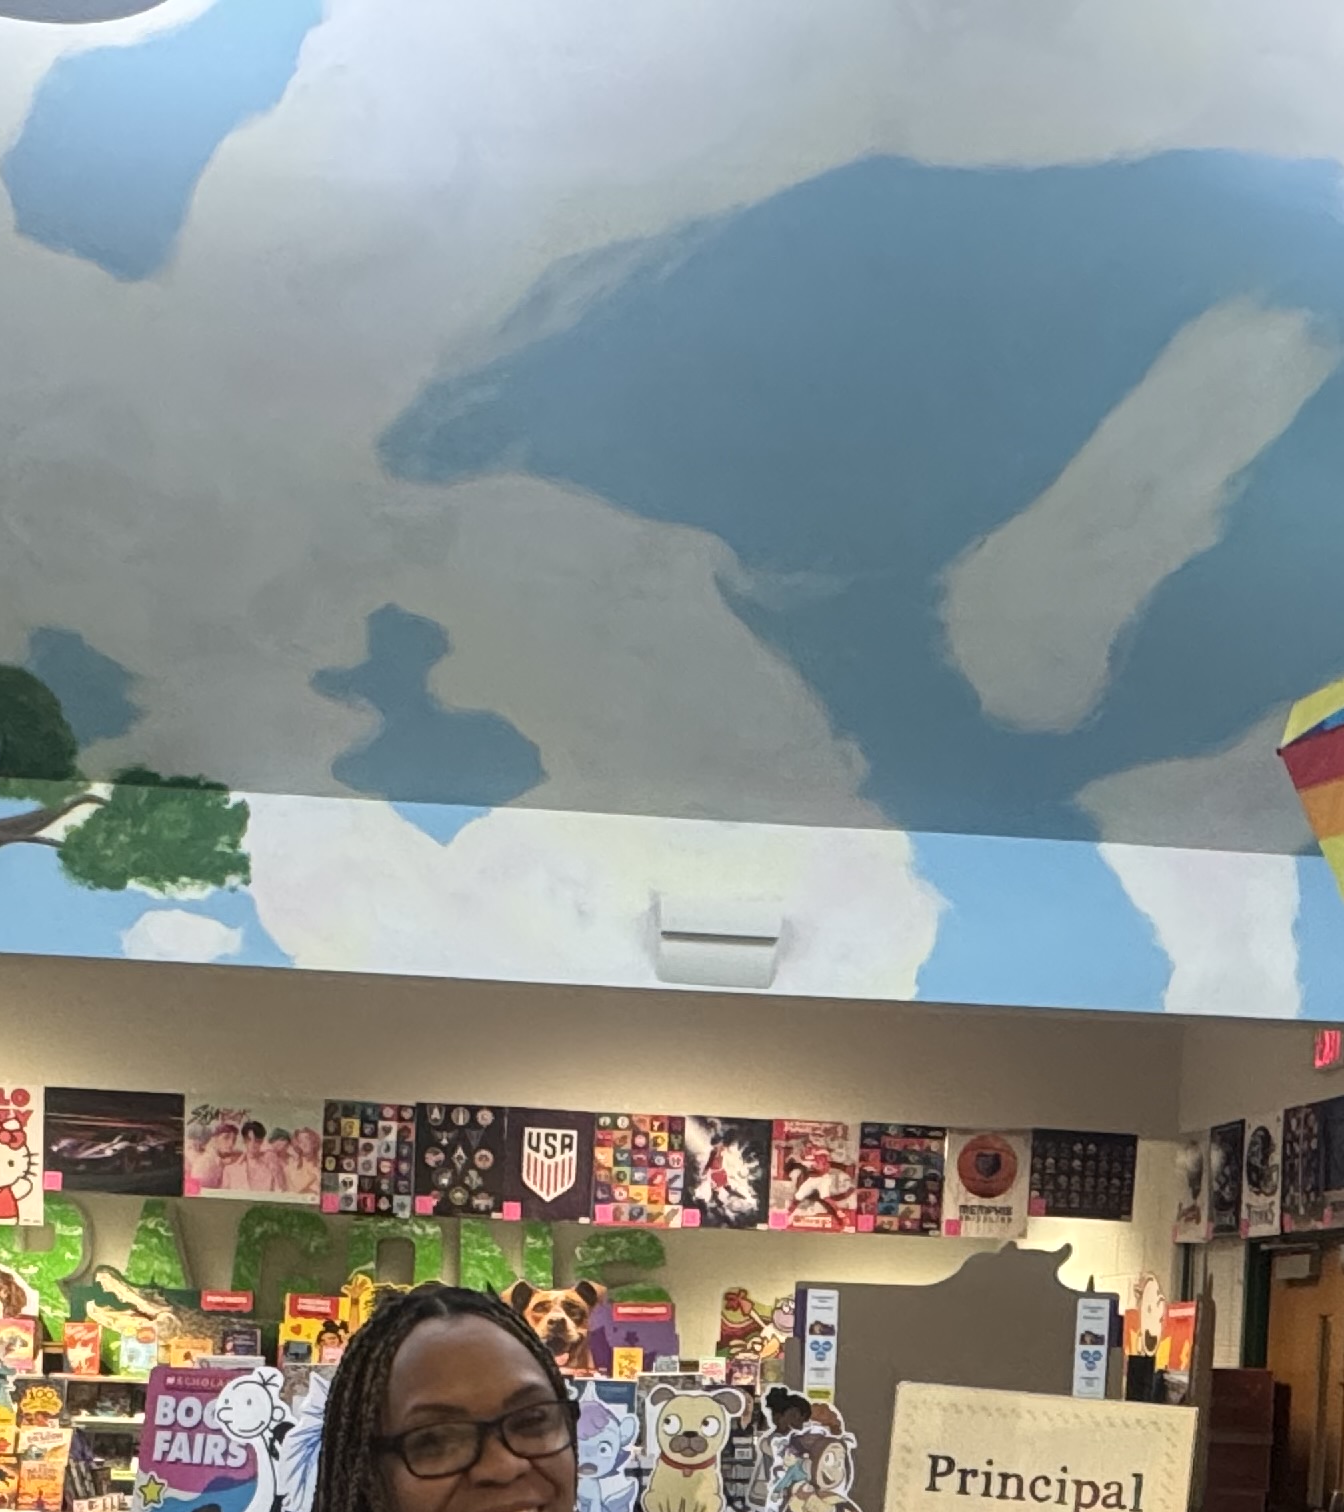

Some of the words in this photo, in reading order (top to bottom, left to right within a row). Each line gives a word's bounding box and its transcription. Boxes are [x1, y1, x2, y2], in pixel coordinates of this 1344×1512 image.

[528, 1131, 574, 1160] USA
[177, 1376, 228, 1389] SCHOLA
[156, 1395, 223, 1430] BOO
[153, 1430, 249, 1468] FAIRS
